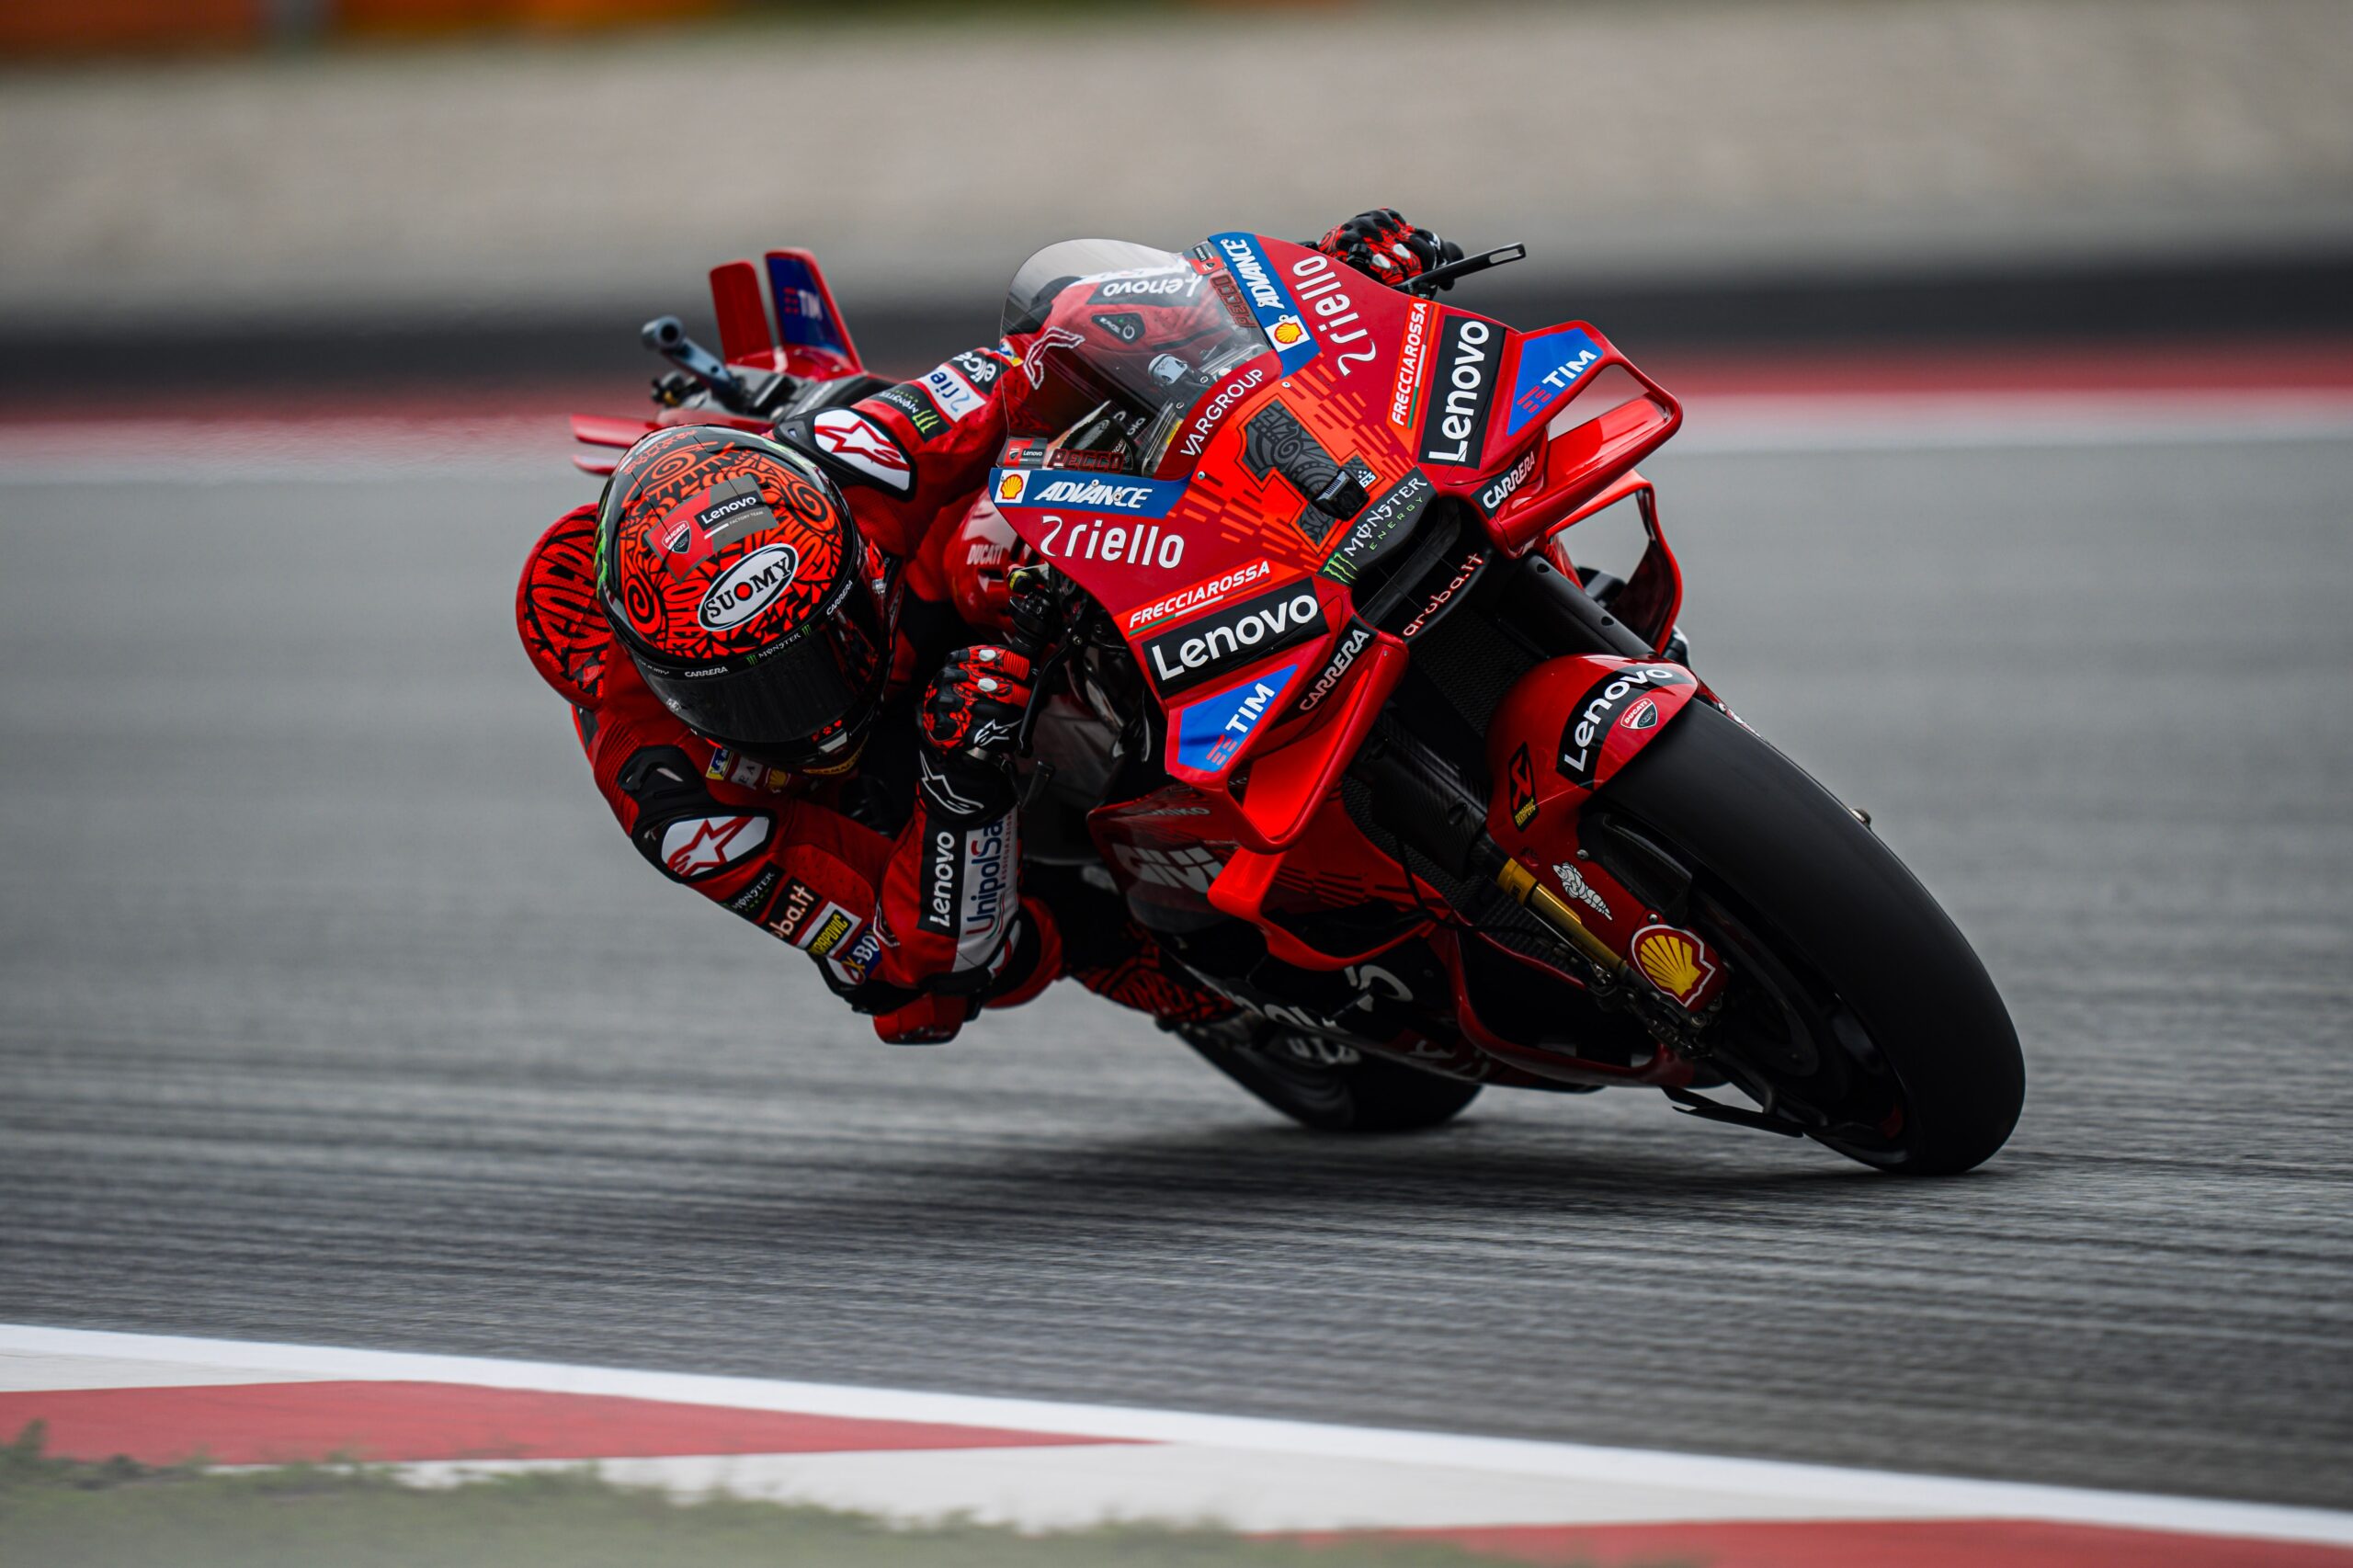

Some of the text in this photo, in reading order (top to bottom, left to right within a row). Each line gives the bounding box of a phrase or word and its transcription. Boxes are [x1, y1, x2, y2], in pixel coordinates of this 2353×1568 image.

[1103, 273, 1203, 298] Lenovo
[1221, 238, 1286, 310] ADVANCE
[1392, 301, 1427, 426] FRECCIAROSSA
[1427, 321, 1490, 462] Lenovo
[1541, 349, 1597, 388] TIM
[1180, 369, 1264, 456] VARGROUP
[1022, 449, 1043, 458] Lenovo
[1047, 448, 1127, 473] PECCO
[1482, 450, 1536, 509] CARRERA
[700, 494, 757, 525] Lenovo
[1033, 480, 1154, 509] ADVANCE
[1343, 477, 1428, 557] MONSTER
[1369, 495, 1424, 551] ENERGY
[664, 523, 687, 544] DUCATI
[966, 543, 1004, 566] DUCATI
[704, 557, 792, 619] SUOMY
[826, 579, 854, 616] CARRERA
[1129, 561, 1271, 629] FRECCIAROSSA
[1402, 552, 1484, 637] aruba.it
[1151, 595, 1319, 681] Lenovo
[684, 665, 729, 677] CARRERA
[1299, 628, 1370, 710] CARRERA
[1224, 682, 1276, 733] TIM
[1563, 668, 1674, 773] Lenovo
[1623, 699, 1648, 724] DUCATI
[929, 831, 955, 927] Lenovo
